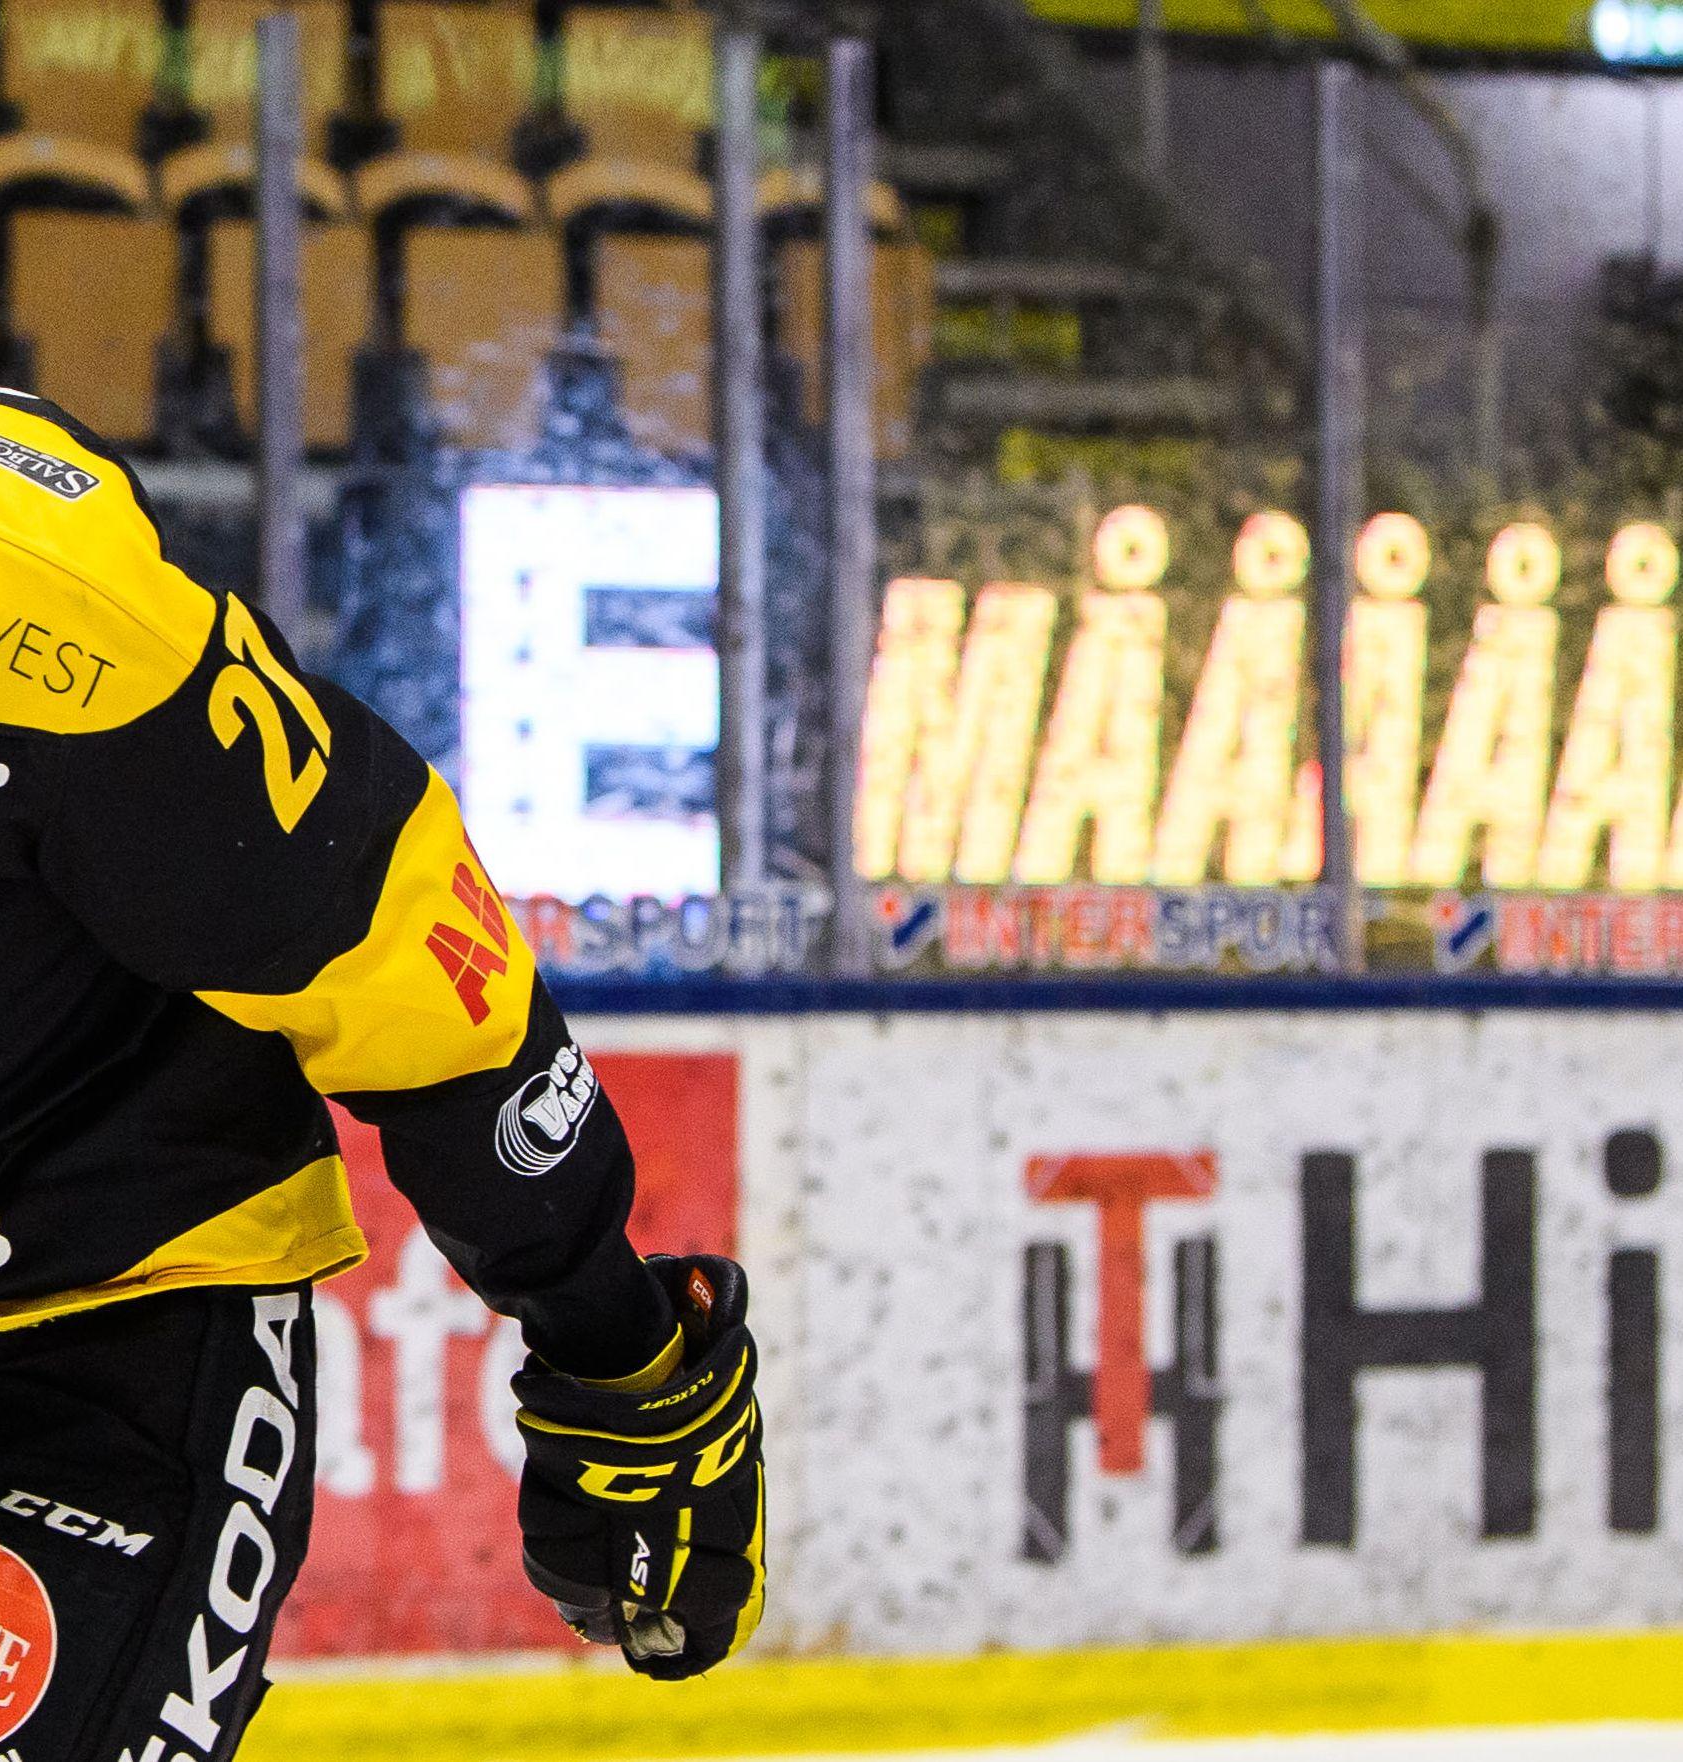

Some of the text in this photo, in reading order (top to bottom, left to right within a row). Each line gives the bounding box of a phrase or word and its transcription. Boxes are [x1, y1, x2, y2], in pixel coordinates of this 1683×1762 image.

[208, 591, 331, 834] 21
[637, 1370, 715, 1411] FLEXCUFF
[576, 1401, 757, 1502] CC
[0, 1488, 155, 1557] CCM
